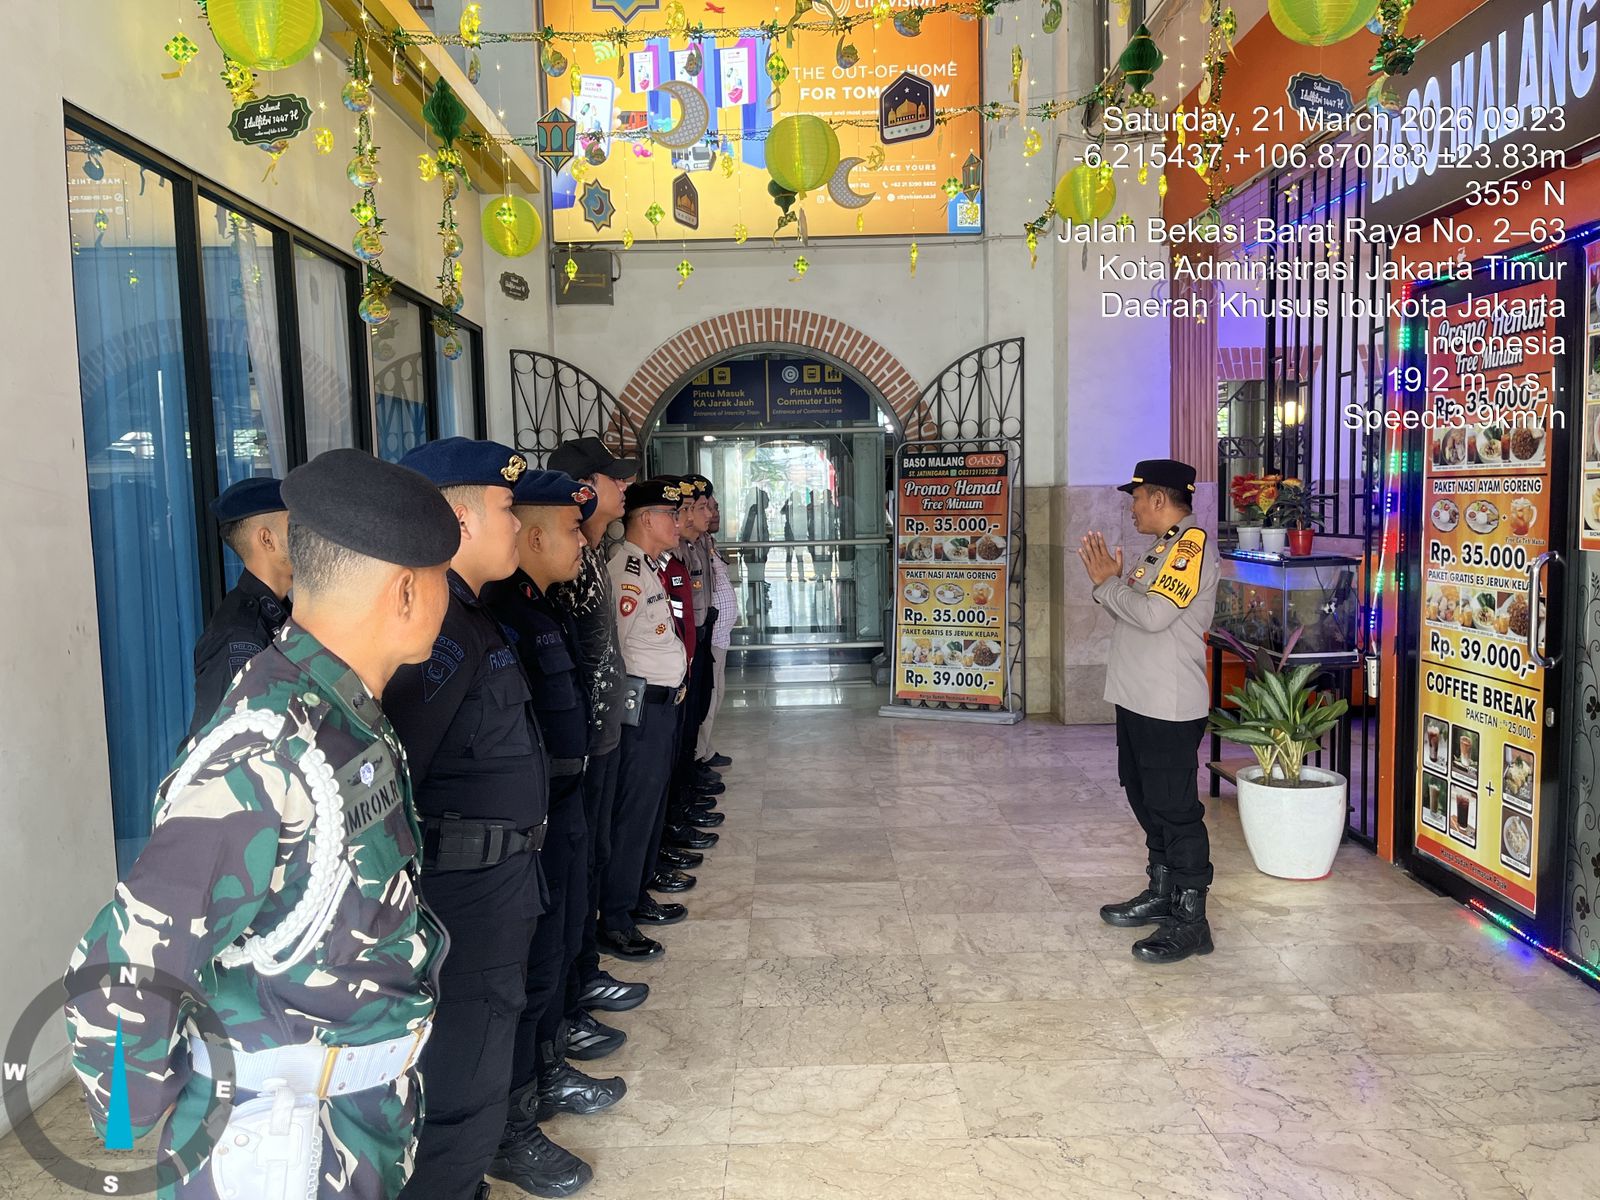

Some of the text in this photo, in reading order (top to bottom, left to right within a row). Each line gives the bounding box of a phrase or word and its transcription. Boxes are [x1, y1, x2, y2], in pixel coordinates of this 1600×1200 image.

[855, 0, 936, 9] citvision
[792, 63, 957, 80] THE OUT-OF-HOME
[800, 85, 950, 100] FOR TOMW
[1313, 82, 1331, 93] Selamat
[259, 102, 280, 113] Selamat
[1324, 97, 1336, 108] 1447
[1337, 98, 1344, 109] H
[1372, 0, 1598, 203] BASO MALANG
[243, 109, 299, 130] Idulfitri 1447 H
[905, 164, 937, 172] YOURS
[1438, 319, 1487, 350] Promo
[1456, 345, 1523, 374] Free Minum
[693, 389, 745, 398] Pintu Masuk
[790, 387, 842, 396] Pintu Masuk
[693, 398, 754, 408] KA Jarak Jauh
[776, 398, 822, 406] Commuter
[1435, 383, 1546, 423] Rp. 35.000,-
[904, 454, 1002, 468] BASO MALANG OASIS
[904, 480, 1002, 496] Promo Hemat
[1434, 479, 1542, 493] PAKET NASI AYAM GORENG
[922, 498, 983, 510] Free Minum
[906, 518, 999, 535] Rp. 35.000,-
[1431, 542, 1532, 574] Rp. 35.000,
[906, 570, 997, 580] PAKET NASI AYAM GORENG
[1428, 570, 1448, 581] PAKET
[1450, 572, 1474, 584] GRATIS
[1476, 575, 1484, 586] ES
[1486, 576, 1510, 588] JERUK
[1158, 574, 1192, 603] POSYAN
[904, 608, 998, 626] Rp. 35.000,-
[1430, 632, 1536, 678] Rp. 39.000,-
[906, 670, 994, 690] Rp. 39.000,-
[1426, 672, 1536, 722] COFFEE BREAK
[1466, 708, 1498, 728] PAKETAN
